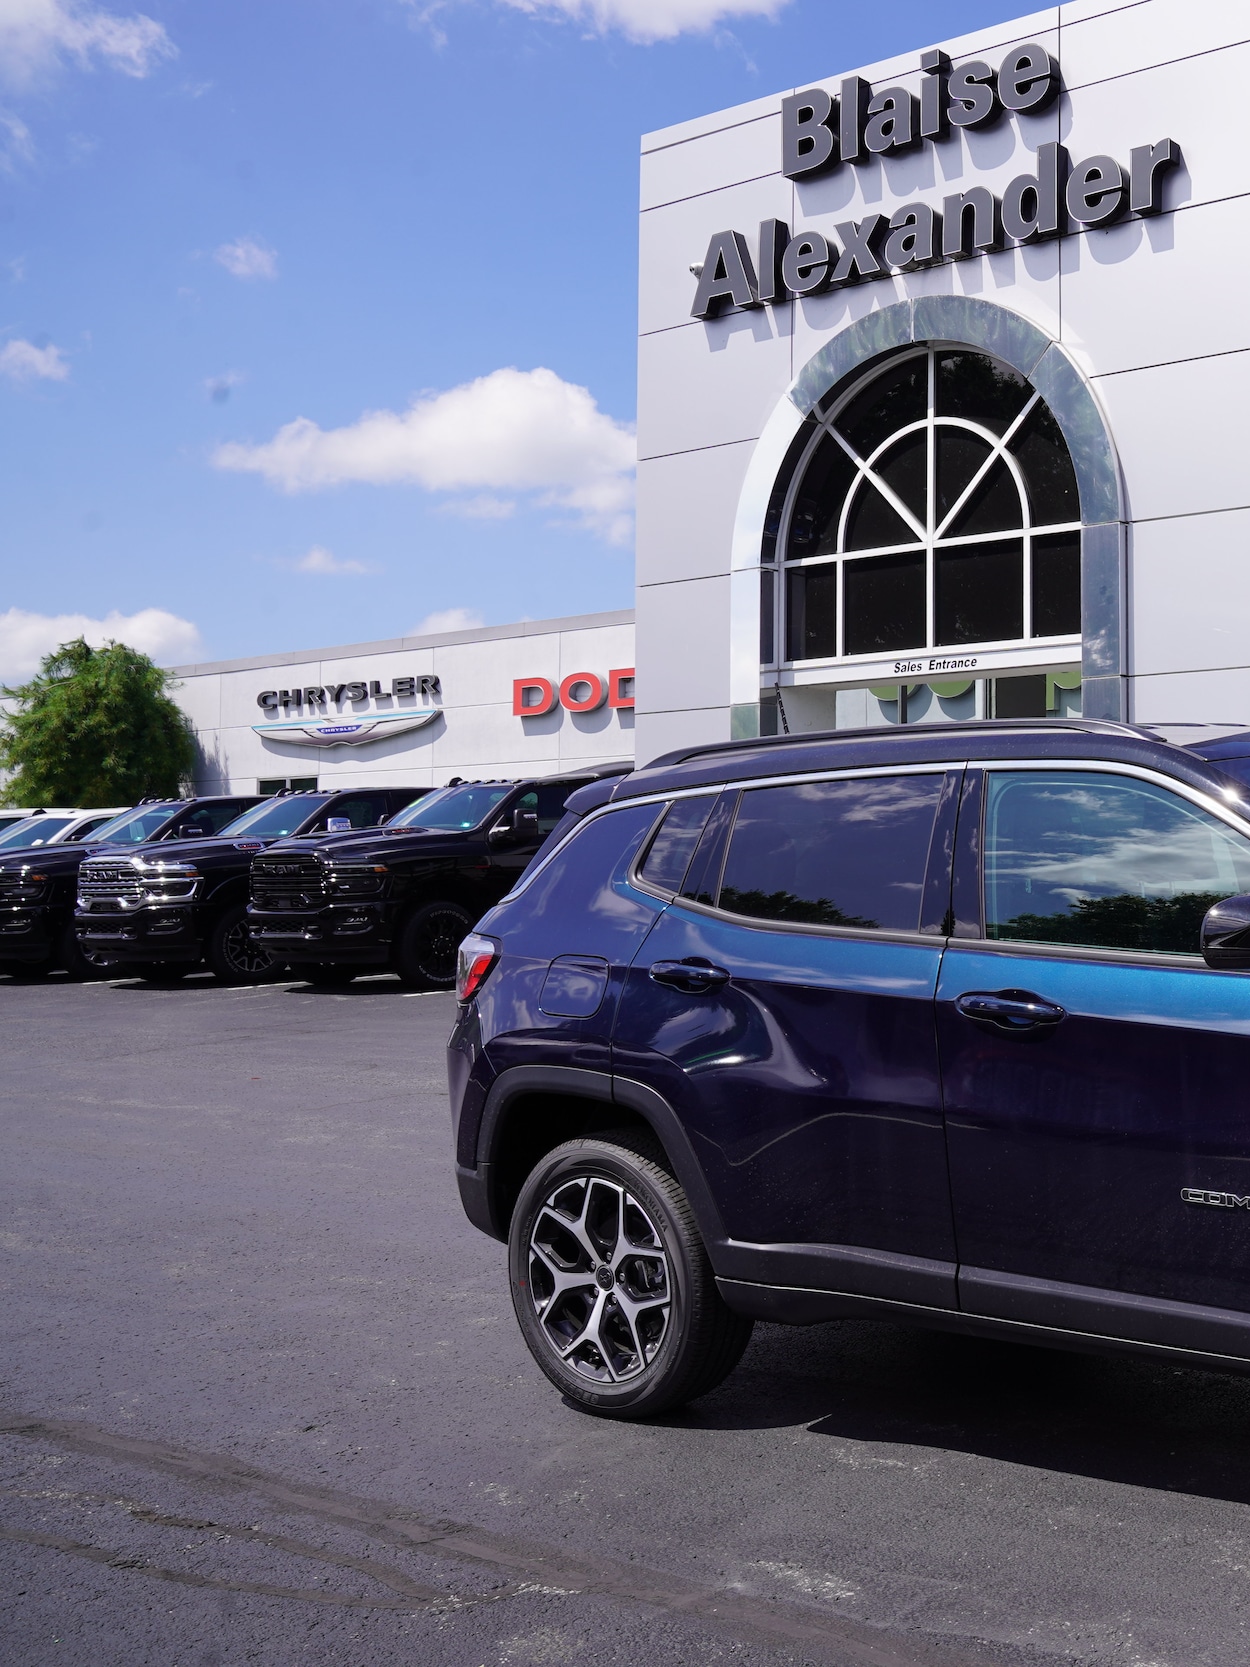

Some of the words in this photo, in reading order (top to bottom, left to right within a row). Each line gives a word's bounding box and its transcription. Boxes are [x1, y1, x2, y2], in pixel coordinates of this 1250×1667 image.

[780, 43, 1062, 179] Blaise
[690, 137, 1180, 319] Alexander
[893, 662, 923, 674] Sales
[928, 657, 978, 671] Entrance
[256, 674, 441, 710] CHRYSLER
[320, 725, 358, 734] CHRYSLER
